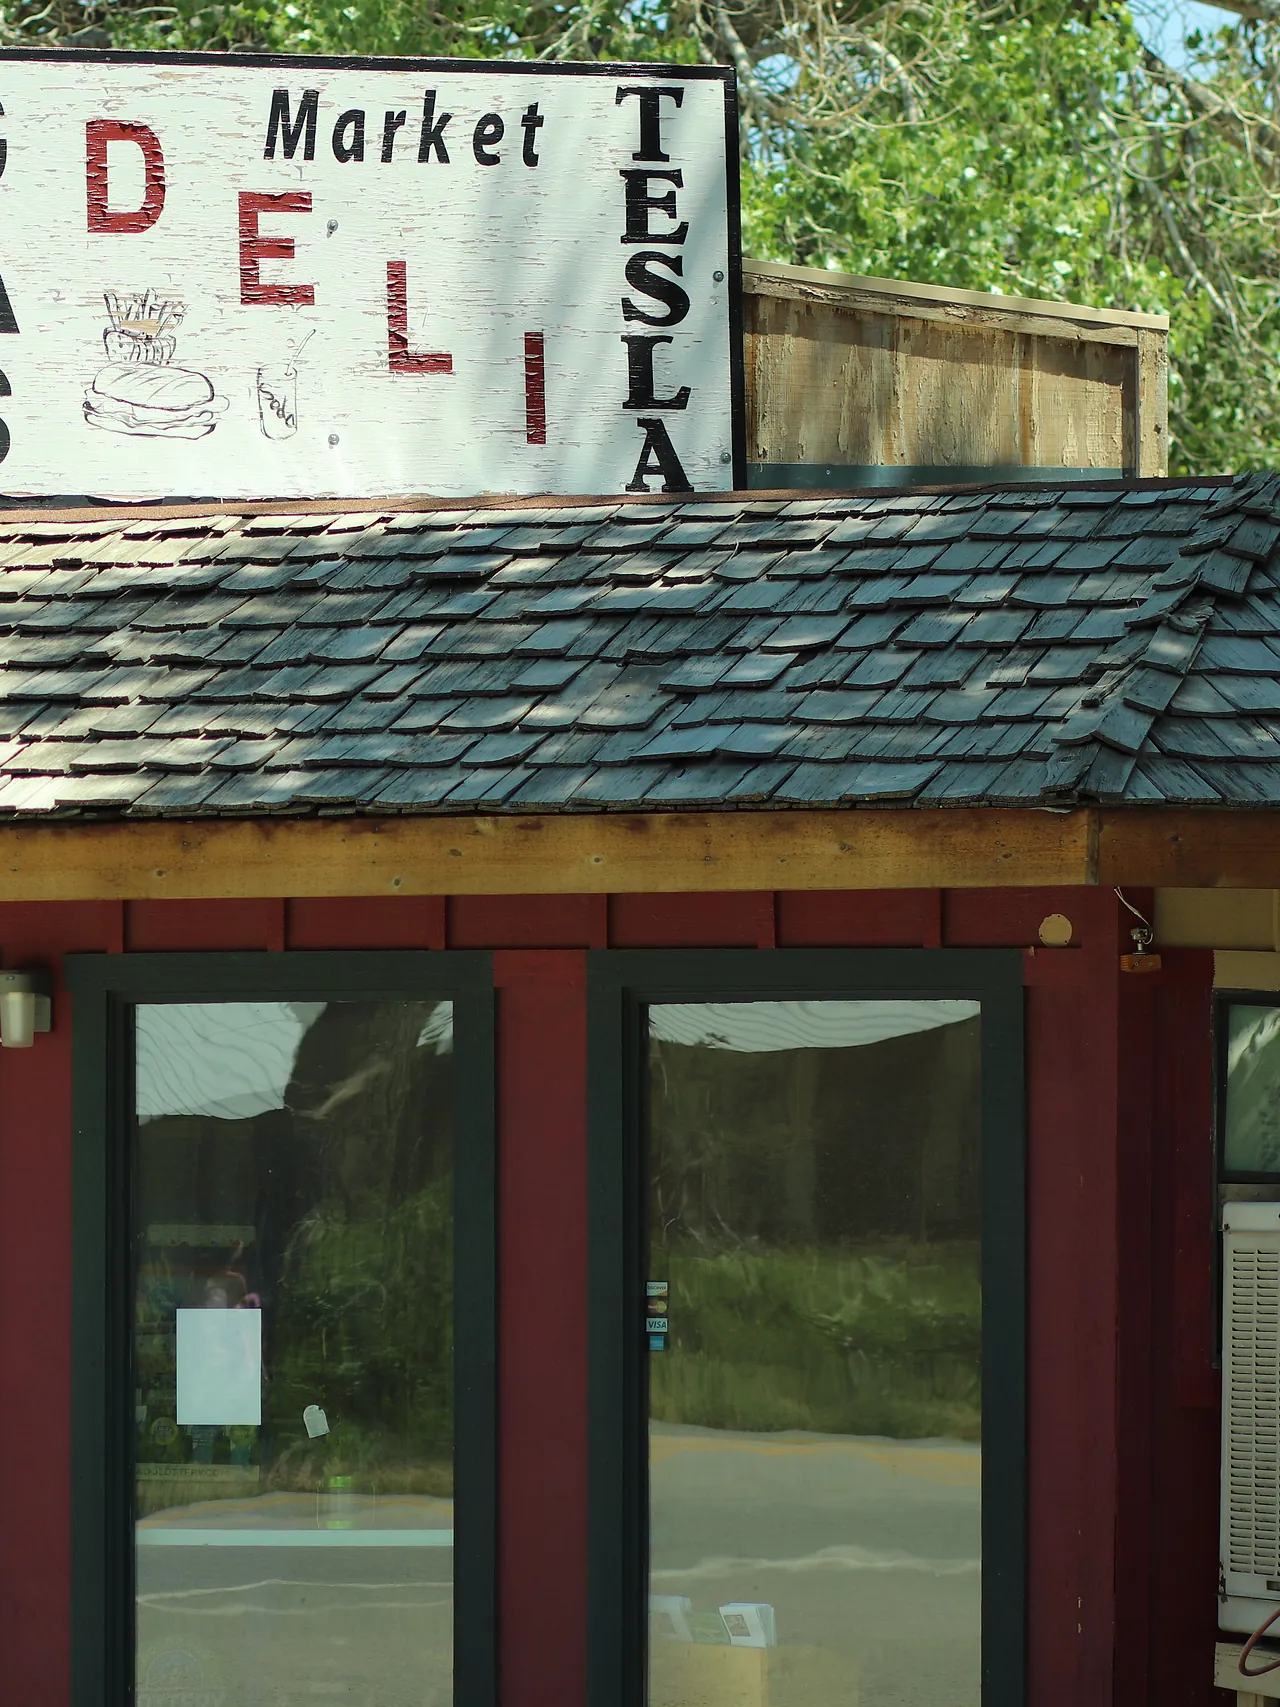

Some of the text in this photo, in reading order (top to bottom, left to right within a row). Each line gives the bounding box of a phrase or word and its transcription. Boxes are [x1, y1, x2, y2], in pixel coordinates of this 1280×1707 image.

[264, 88, 545, 167] Market
[85, 118, 547, 446] DELI
[615, 86, 695, 493] TESLA
[648, 1321, 667, 1329] VISA
